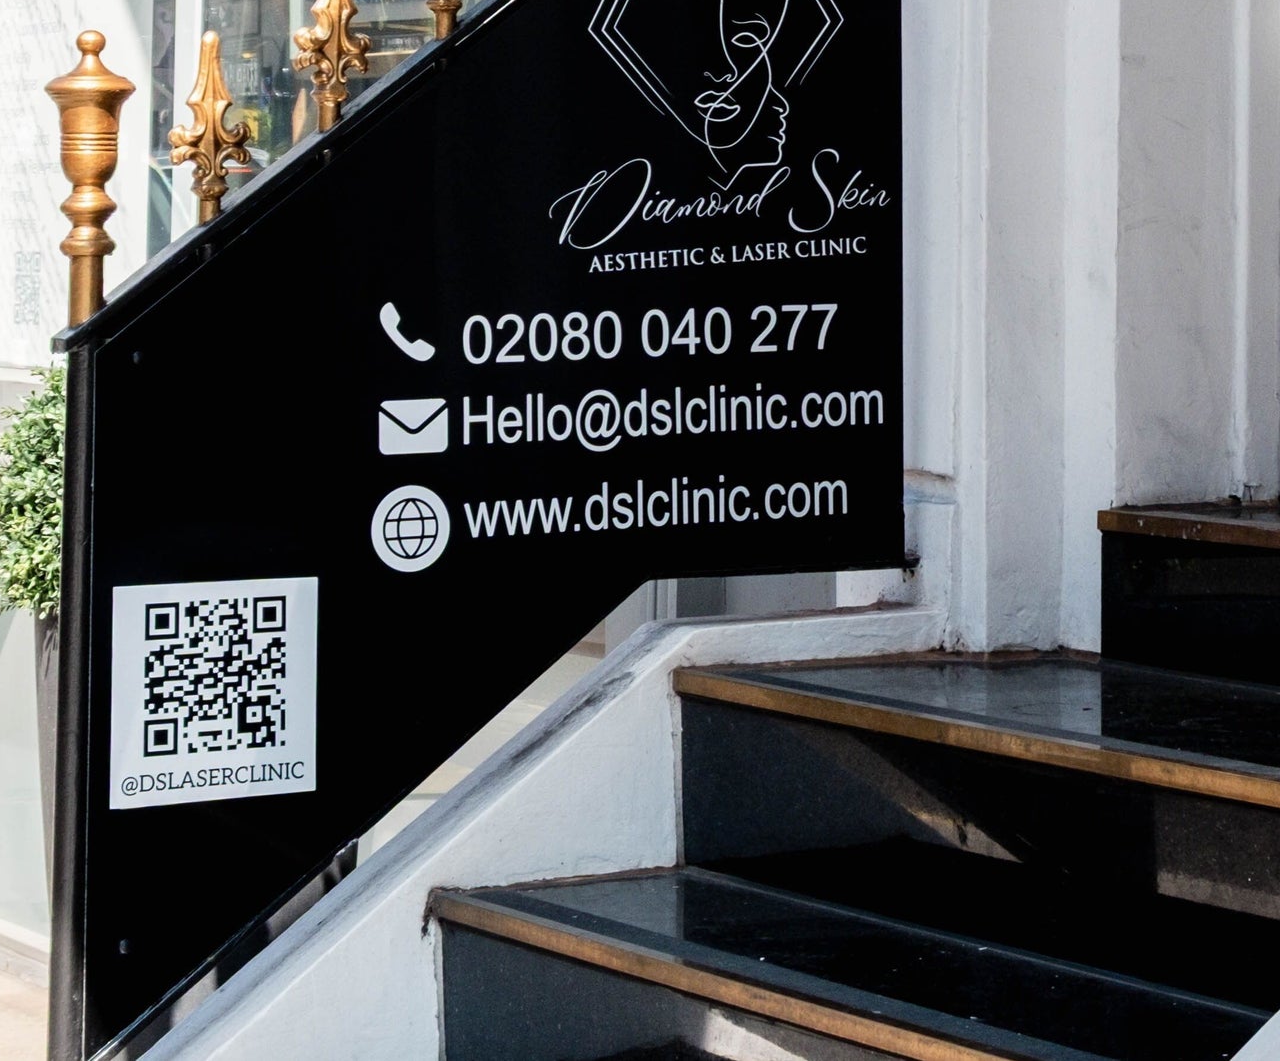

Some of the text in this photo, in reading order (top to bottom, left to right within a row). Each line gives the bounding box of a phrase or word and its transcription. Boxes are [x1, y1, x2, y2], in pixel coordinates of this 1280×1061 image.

[549, 149, 891, 250] Diamond Skin
[589, 236, 868, 274] AESTHETIC & LASER CLINIC
[462, 304, 838, 365] 02080 040 277
[462, 383, 884, 453] Hello@dslclinic.com
[463, 475, 849, 538] www.dslclinic.com
[121, 760, 306, 796] @DSLASERCLINIC
